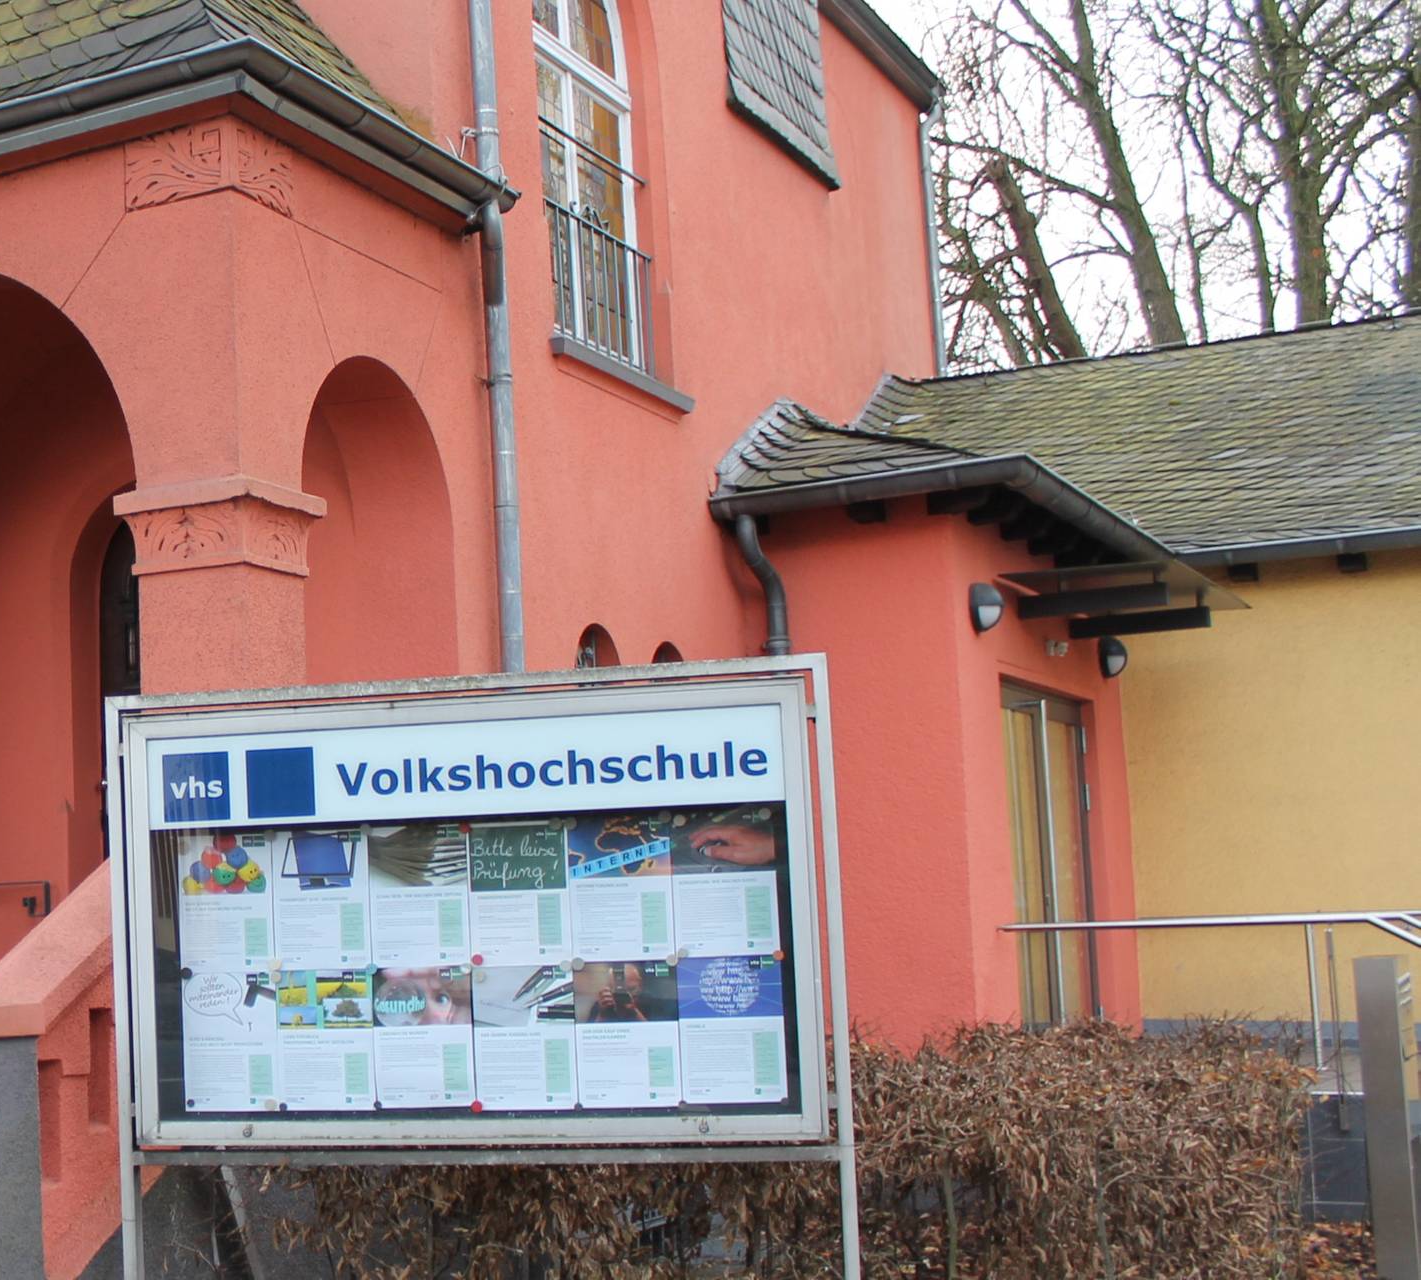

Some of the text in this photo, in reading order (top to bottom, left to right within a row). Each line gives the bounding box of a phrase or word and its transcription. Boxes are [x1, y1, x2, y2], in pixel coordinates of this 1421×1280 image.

[336, 741, 768, 796] Volkshochschule
[170, 776, 224, 799] vhs
[470, 834, 558, 857] Bitte leise
[572, 840, 670, 878] INTERNET
